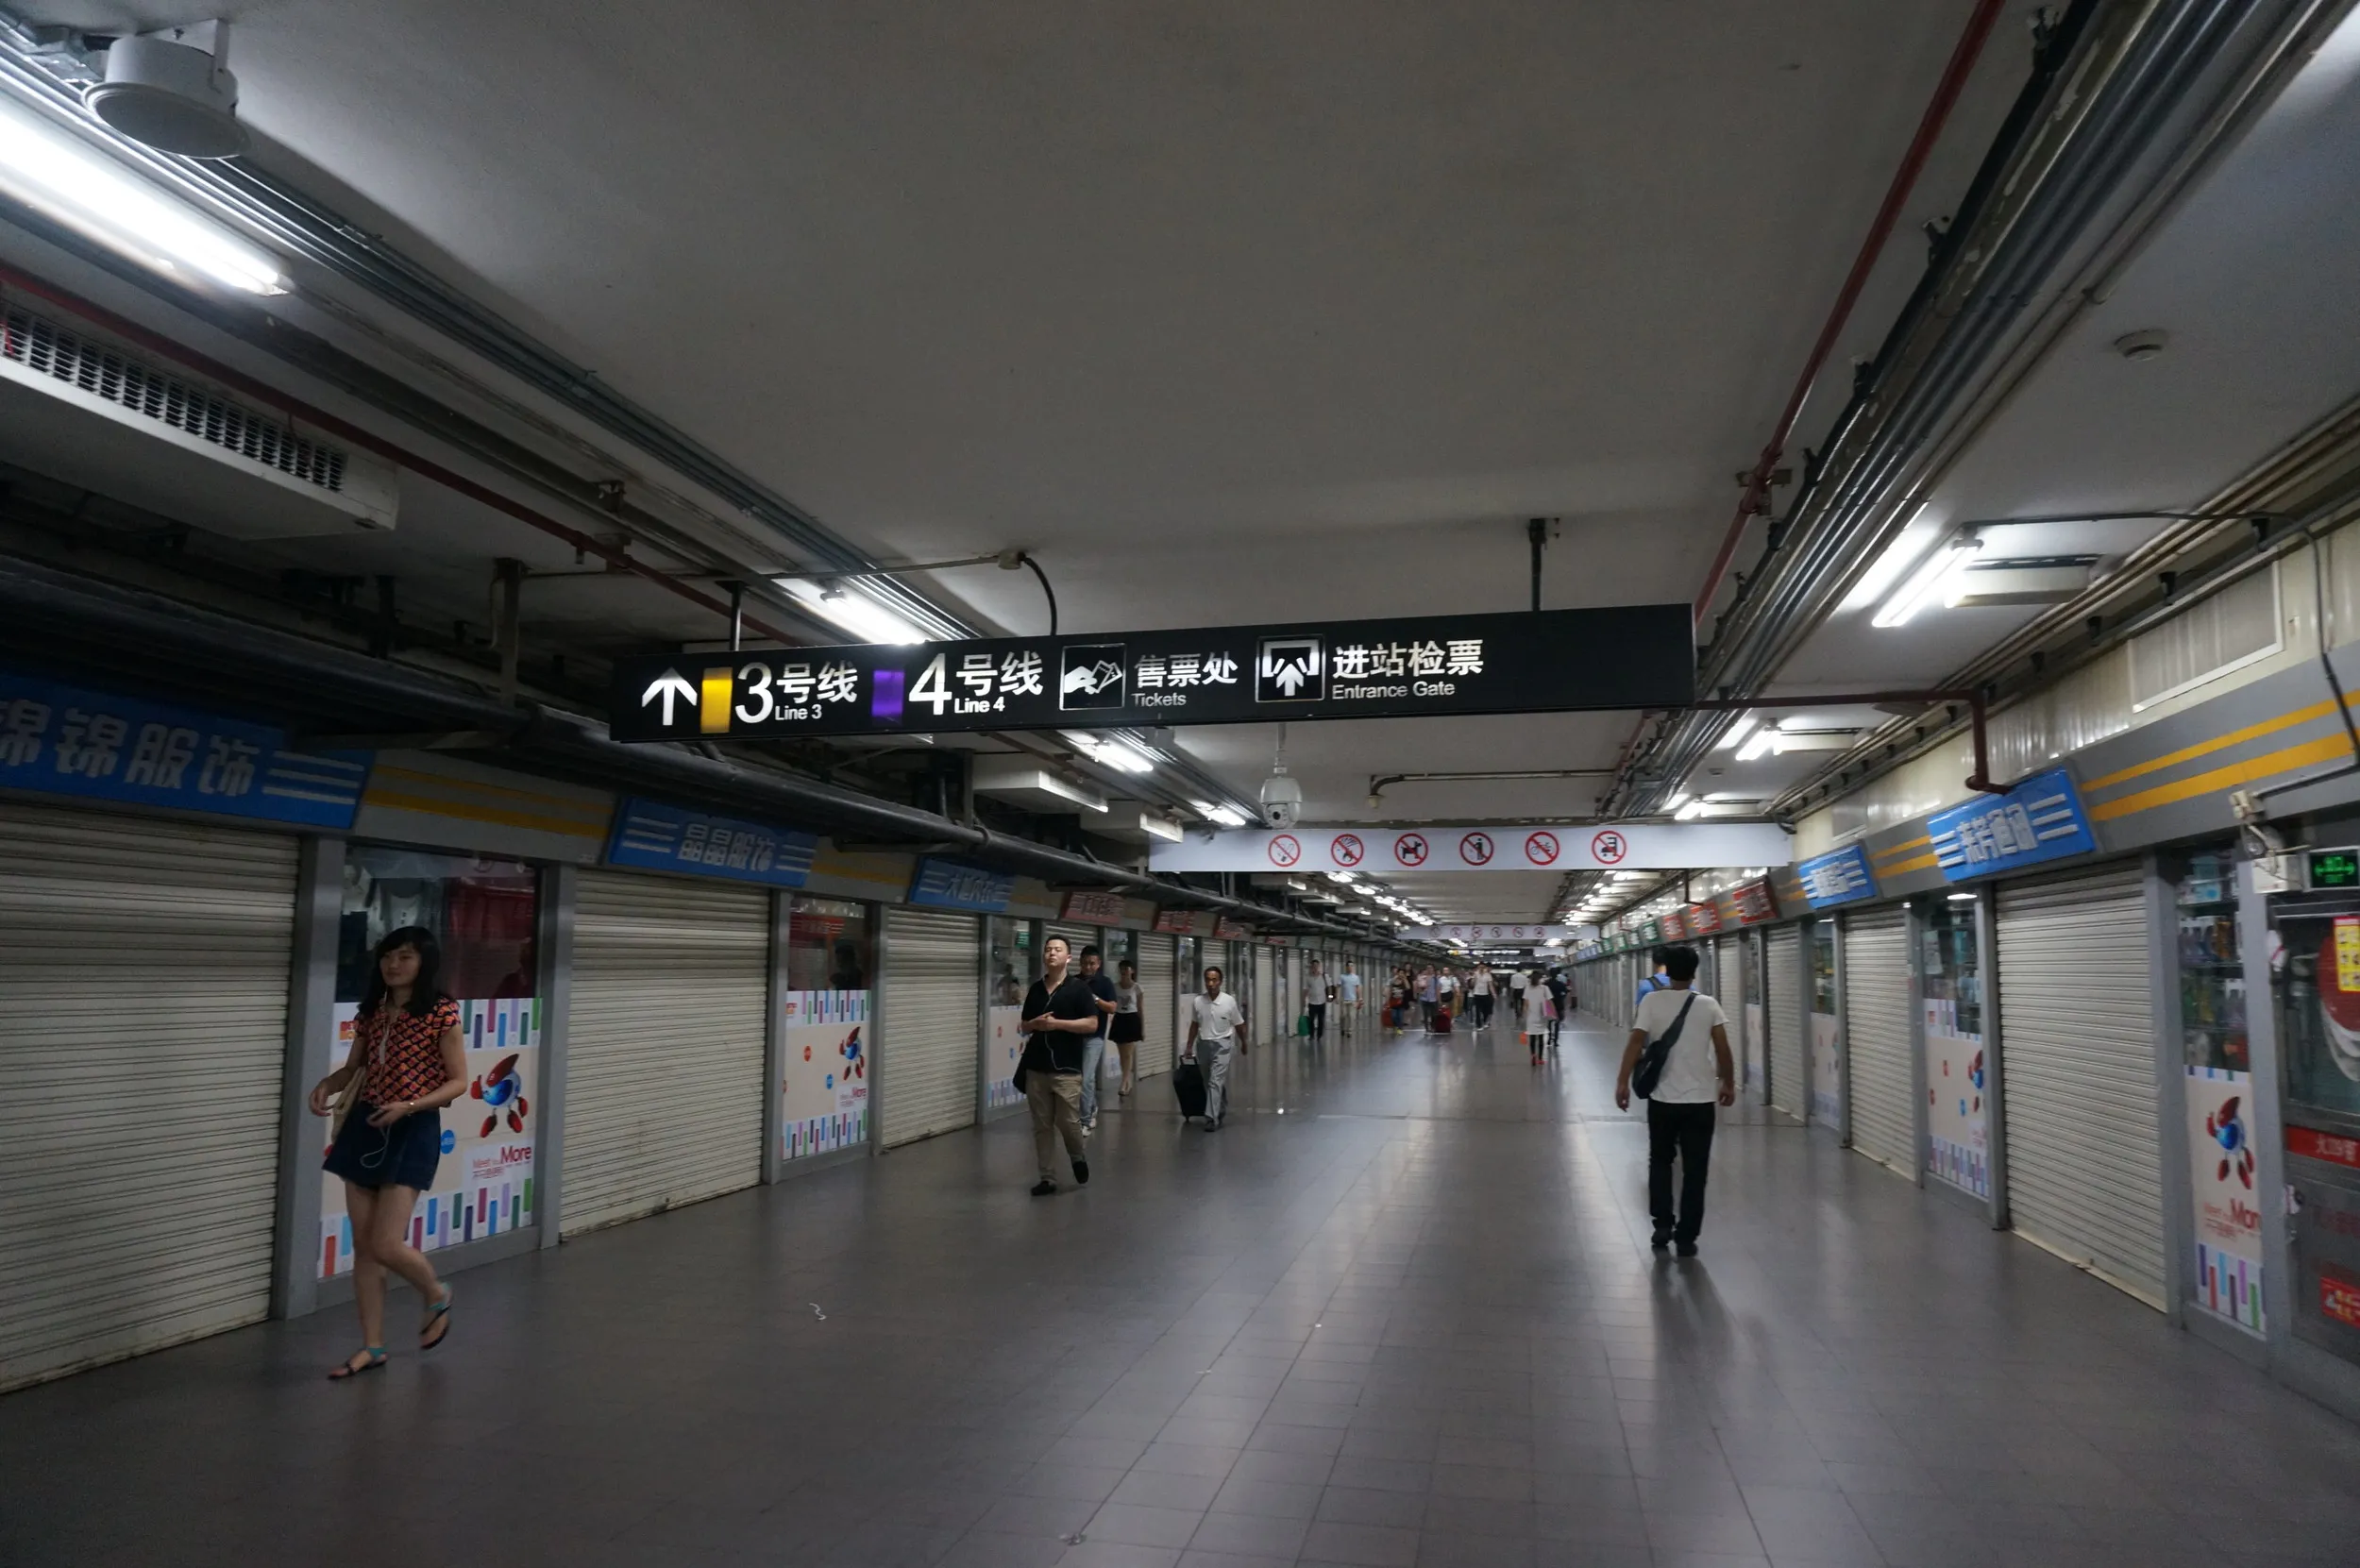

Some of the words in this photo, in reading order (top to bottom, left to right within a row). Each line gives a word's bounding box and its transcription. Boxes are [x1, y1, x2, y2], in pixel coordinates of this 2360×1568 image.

[1332, 638, 1484, 679] 进站检票
[1134, 649, 1239, 689] 售票处
[734, 659, 858, 724] 3号线
[908, 650, 1044, 717] 4号线
[1332, 681, 1408, 700] Entrance
[1412, 680, 1456, 698] Gate
[954, 698, 990, 715] Line
[993, 697, 1005, 713] 4
[1133, 690, 1187, 708] Tickets
[775, 705, 807, 722] Line
[811, 704, 823, 720] 3
[500, 1145, 532, 1164] More
